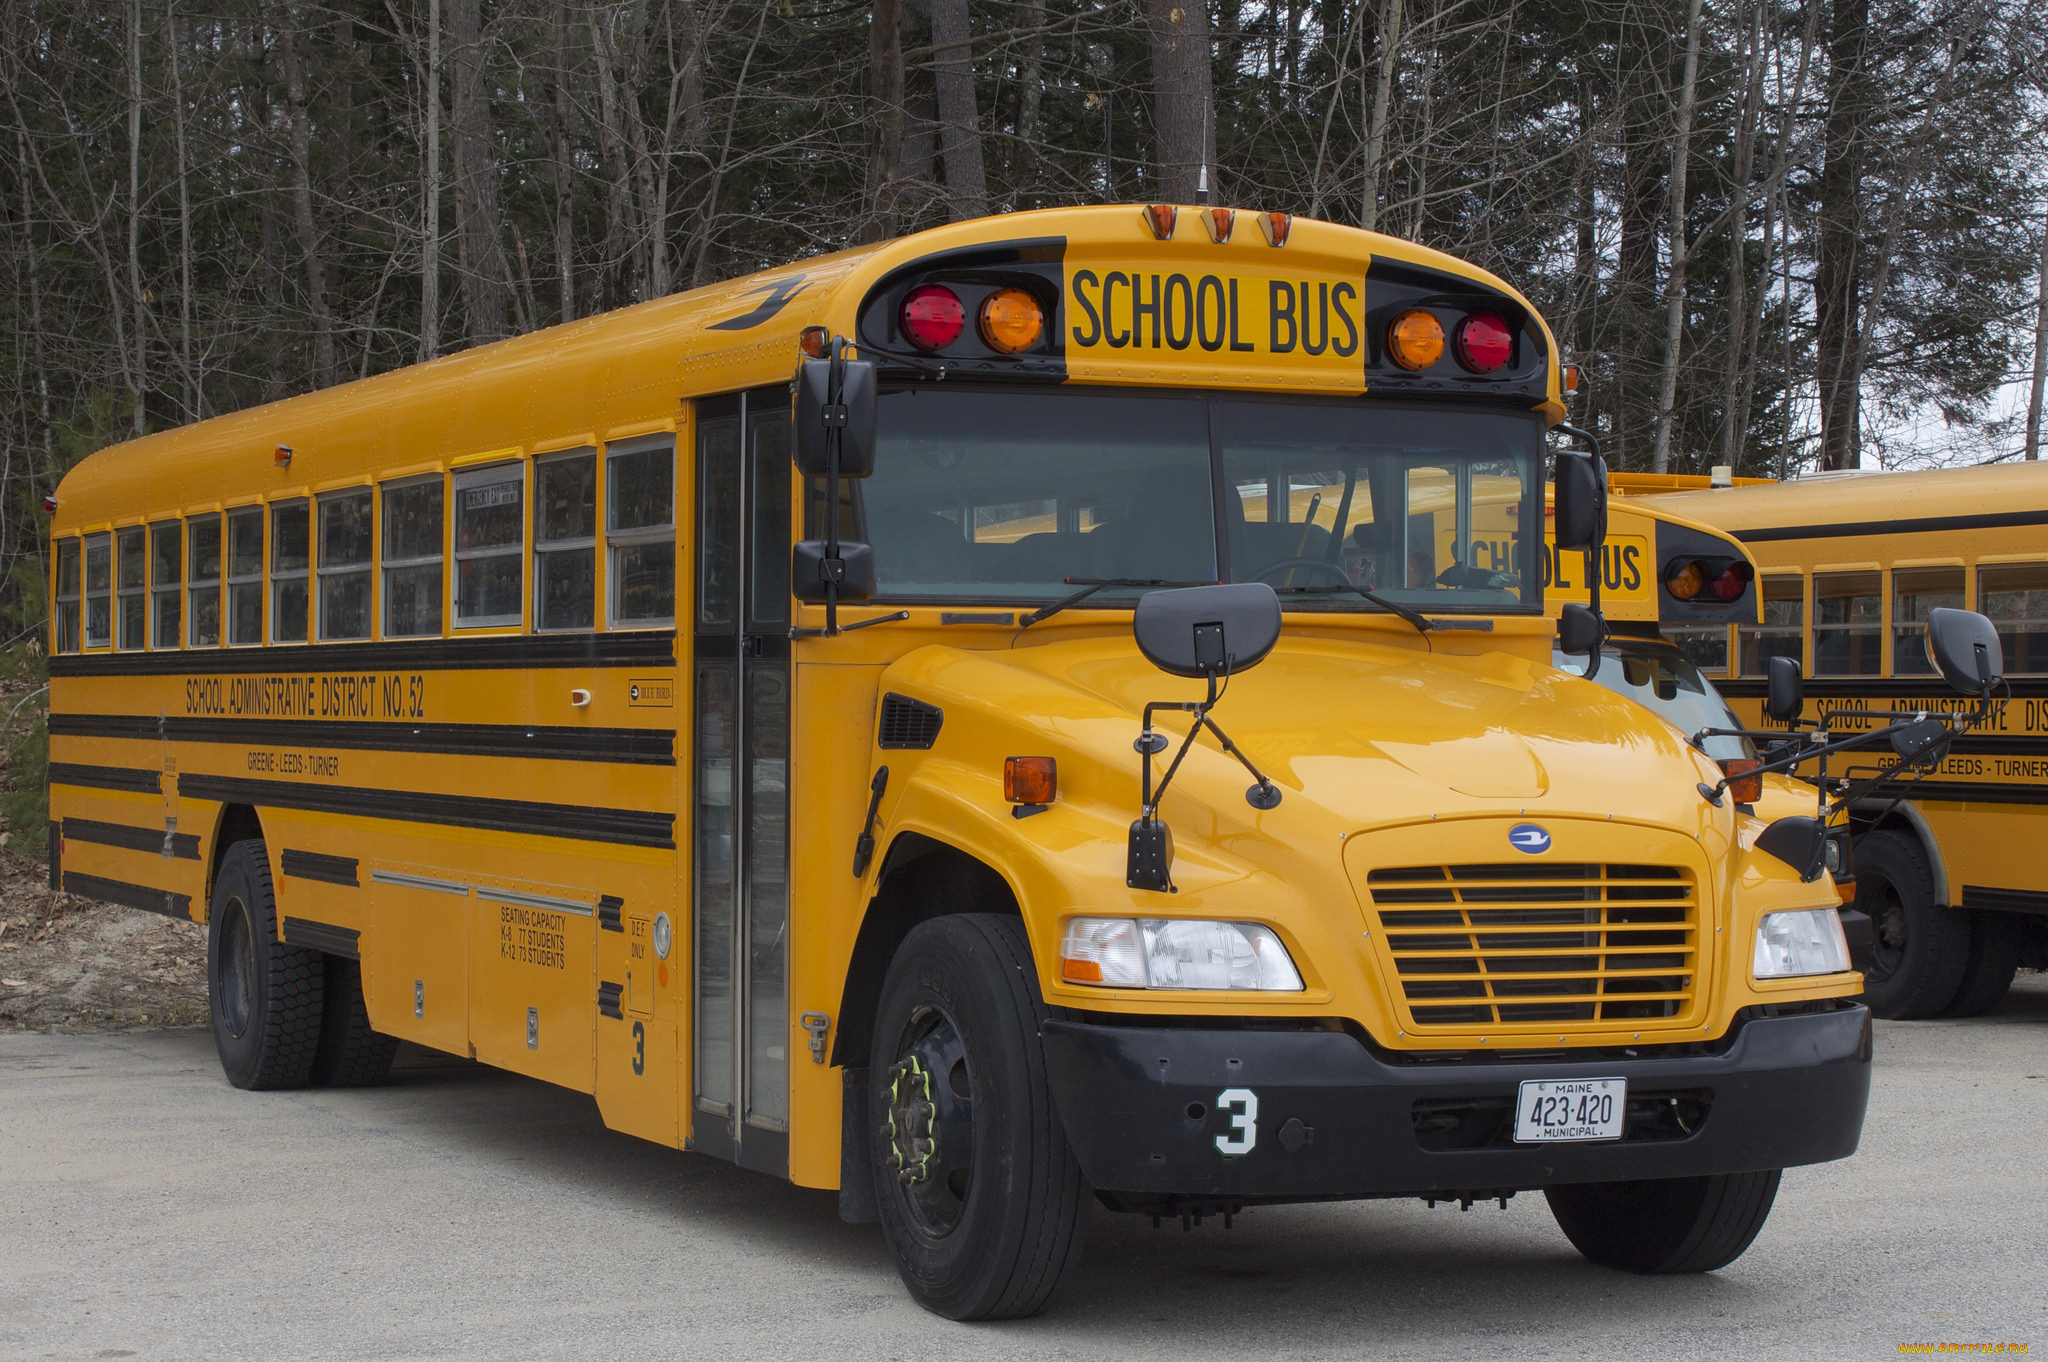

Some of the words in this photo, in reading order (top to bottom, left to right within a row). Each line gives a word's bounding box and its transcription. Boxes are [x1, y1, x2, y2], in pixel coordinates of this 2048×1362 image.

[1072, 269, 1255, 352] SCHOOL
[1269, 279, 1359, 358] BUS
[186, 677, 225, 714] SCHOOL
[229, 677, 315, 716] ADMINISTRATIVE
[321, 676, 376, 717] DISTRICT
[383, 675, 405, 718] NO.
[409, 675, 424, 718] 52
[1817, 698, 1872, 729] SCHOOL
[2025, 700, 2048, 731] DIS
[248, 752, 274, 772] GREENE
[280, 753, 303, 774] LEEDS
[308, 755, 339, 777] TURNER
[1940, 759, 1983, 775] LEEDS
[1995, 760, 2048, 777] TURNER
[501, 906, 530, 927] SEATING
[531, 911, 566, 932] CAPACITY
[631, 921, 646, 938] D.E.F.
[501, 925, 512, 942] K-8
[518, 928, 527, 944] 77
[527, 930, 565, 951] STUDENTS
[631, 942, 645, 959] ONLY
[501, 942, 516, 960] K-12
[519, 945, 527, 962] 73
[528, 947, 565, 970] STUDENTS
[632, 1020, 645, 1076] 3
[1555, 1084, 1593, 1094] MAINE
[1213, 1087, 1259, 1156] 3
[1544, 1127, 1598, 1137] MUNICIPAL
